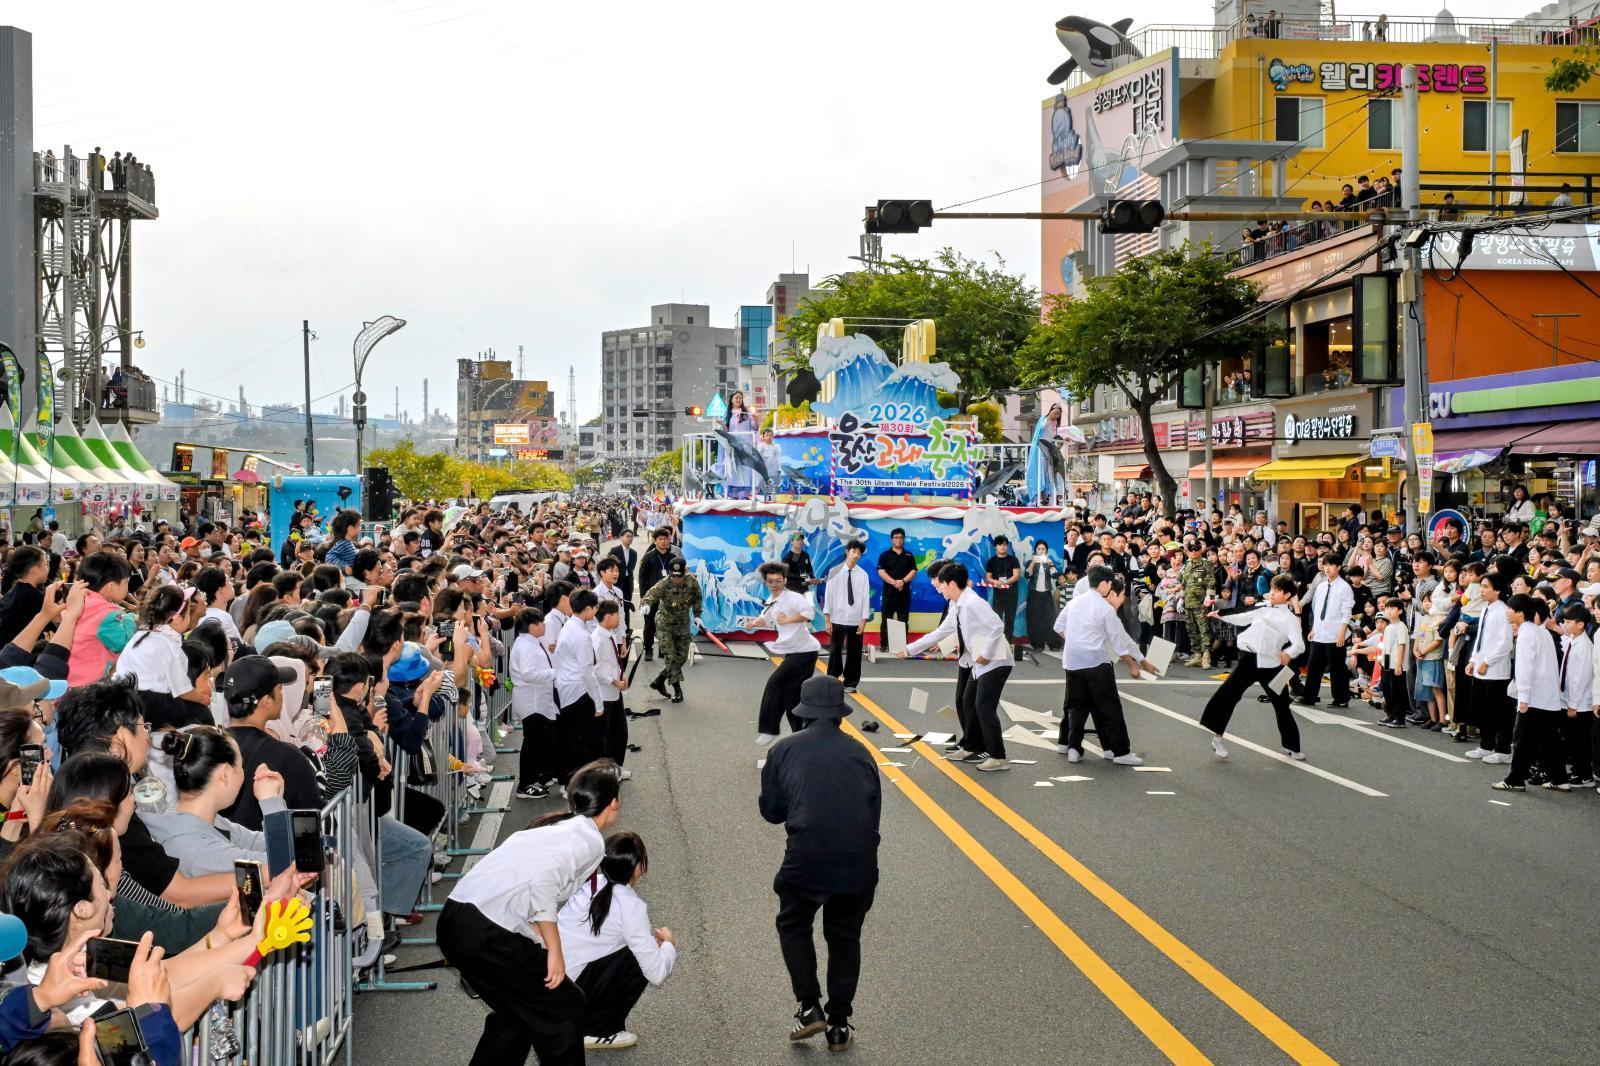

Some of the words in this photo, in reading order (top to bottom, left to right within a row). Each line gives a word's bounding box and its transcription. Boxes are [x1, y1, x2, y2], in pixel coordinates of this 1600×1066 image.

[869, 403, 925, 424] 2026
[1429, 391, 1450, 419] CU
[880, 423, 914, 434] 제30회
